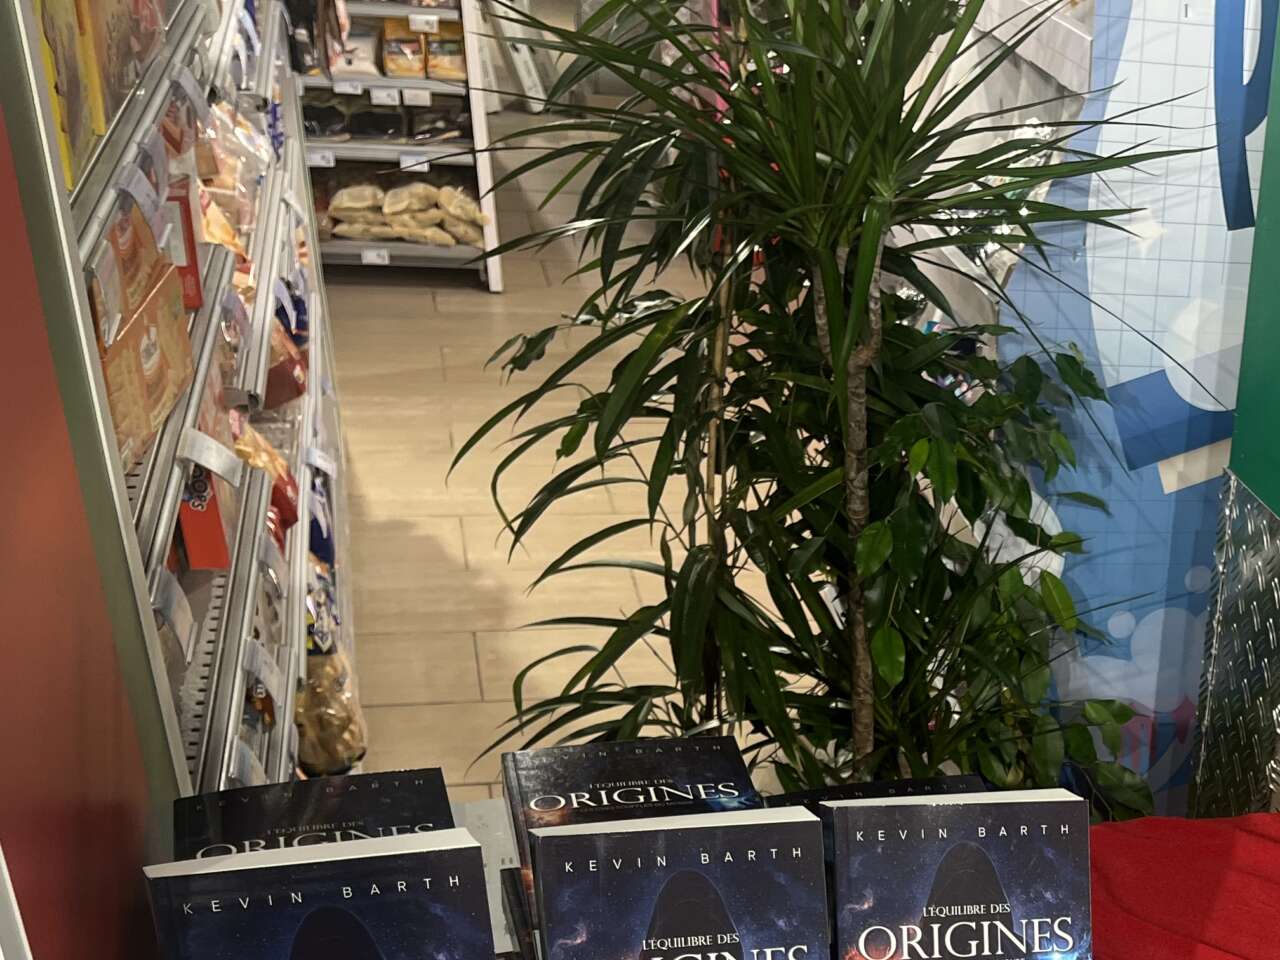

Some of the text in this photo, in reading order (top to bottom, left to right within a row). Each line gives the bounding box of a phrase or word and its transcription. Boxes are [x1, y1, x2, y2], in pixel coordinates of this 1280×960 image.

[326, 779, 424, 793] BARTH
[529, 782, 739, 812] ORIGINES
[856, 824, 1069, 841] KEVIN BARTH
[564, 847, 802, 873] KEVIN BARTH
[183, 875, 460, 914] KEVIN BARTH
[990, 903, 1011, 913] DES
[717, 932, 740, 944] DES
